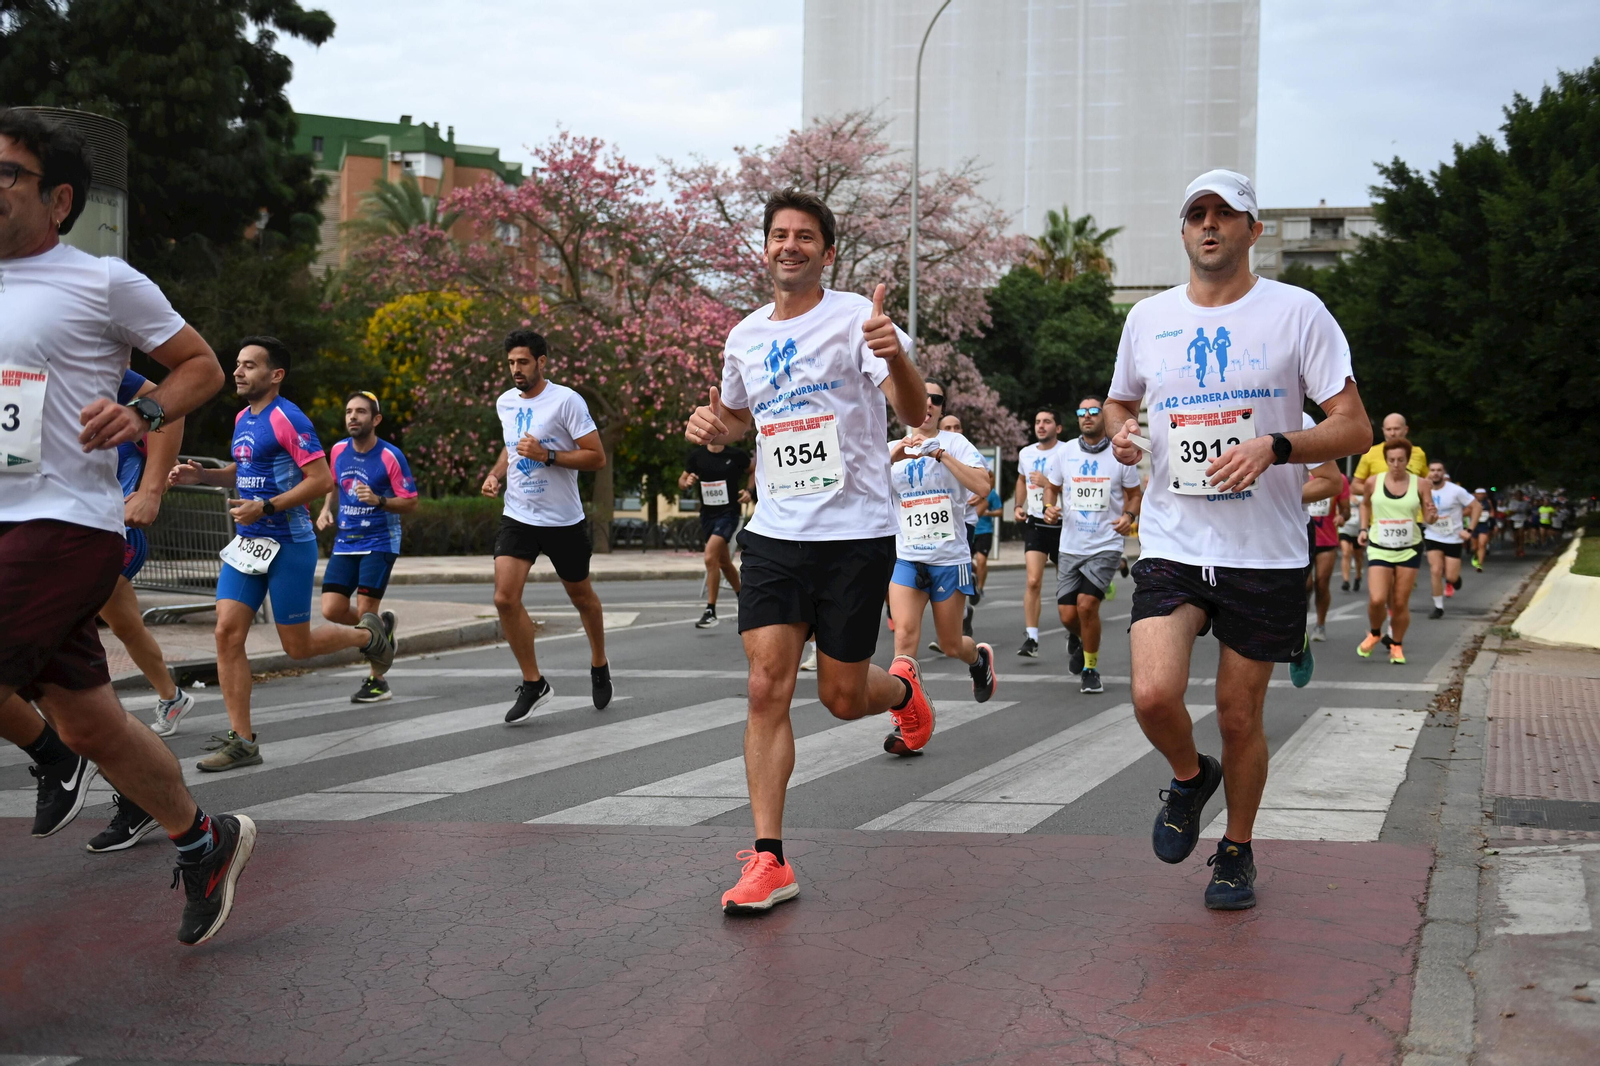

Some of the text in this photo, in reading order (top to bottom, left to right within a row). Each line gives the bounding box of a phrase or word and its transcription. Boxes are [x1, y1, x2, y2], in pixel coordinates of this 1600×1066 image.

[796, 382, 829, 396] URBANA
[1165, 396, 1179, 409] 42
[1181, 391, 1230, 406] CARRERA
[1231, 388, 1271, 399] URBANA
[760, 423, 776, 437] 42
[773, 440, 827, 468] 1354
[705, 489, 724, 497] 1680
[1077, 487, 1104, 498] 9071
[906, 510, 949, 528] 13198
[1383, 528, 1408, 538] 3799
[237, 537, 272, 561] 13980
